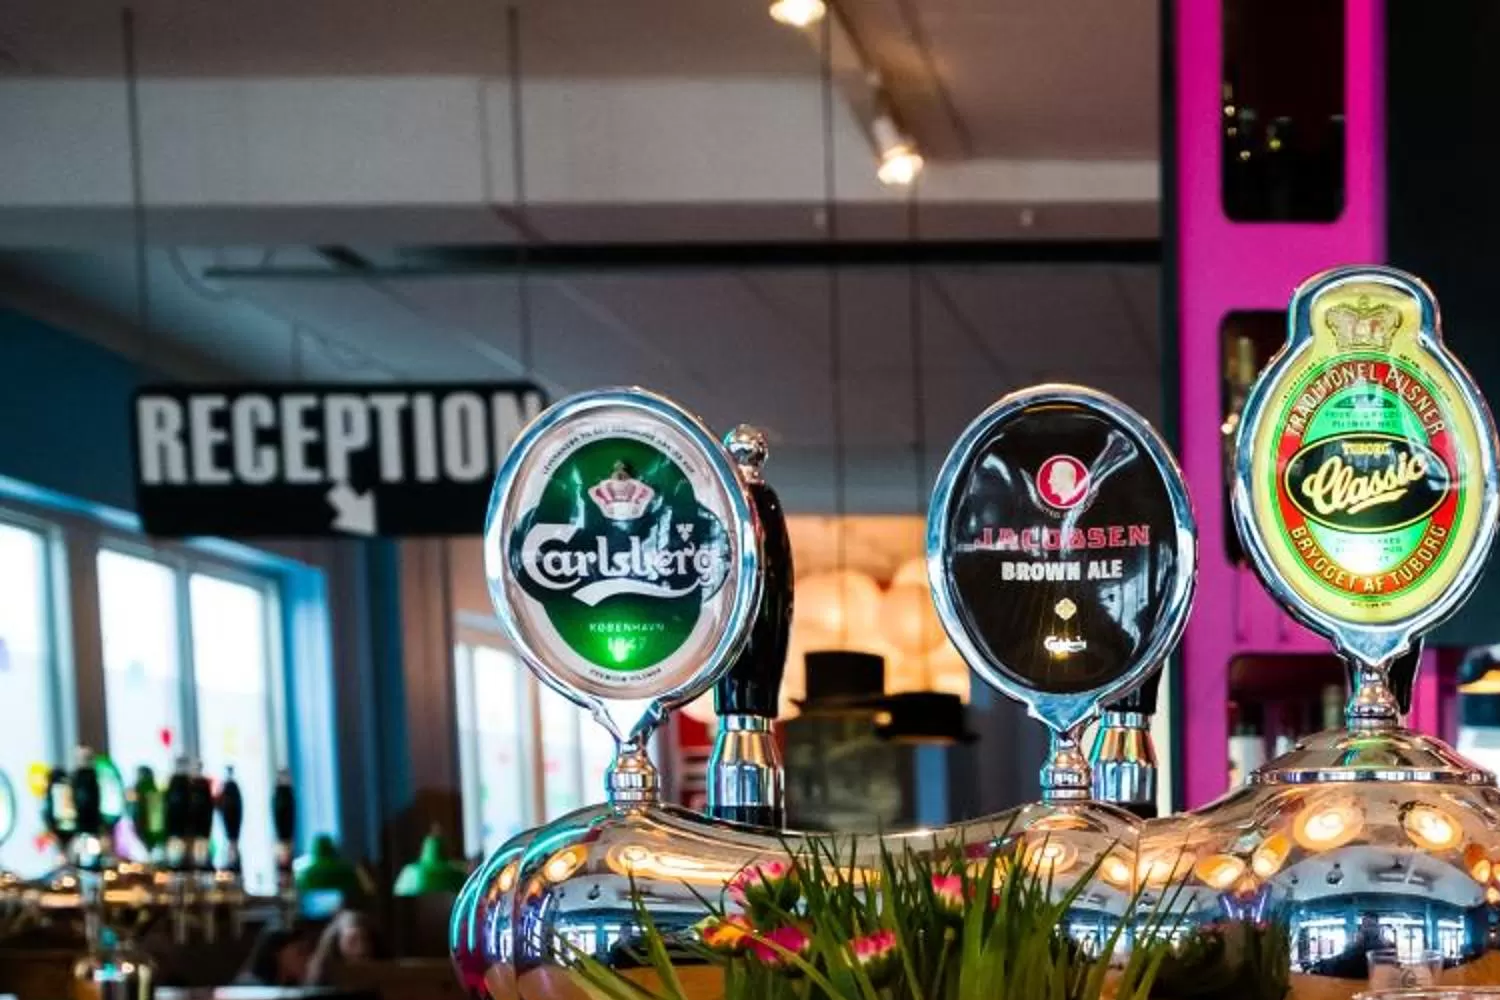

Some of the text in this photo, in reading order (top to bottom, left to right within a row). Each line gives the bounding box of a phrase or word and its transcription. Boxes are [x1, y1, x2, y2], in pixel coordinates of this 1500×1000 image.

[136, 393, 543, 484] RECEPTION
[1301, 452, 1427, 515] Classic
[521, 523, 718, 590] Carlsberg
[1001, 559, 1124, 581] BROWN ALE
[1363, 576, 1386, 592] AF
